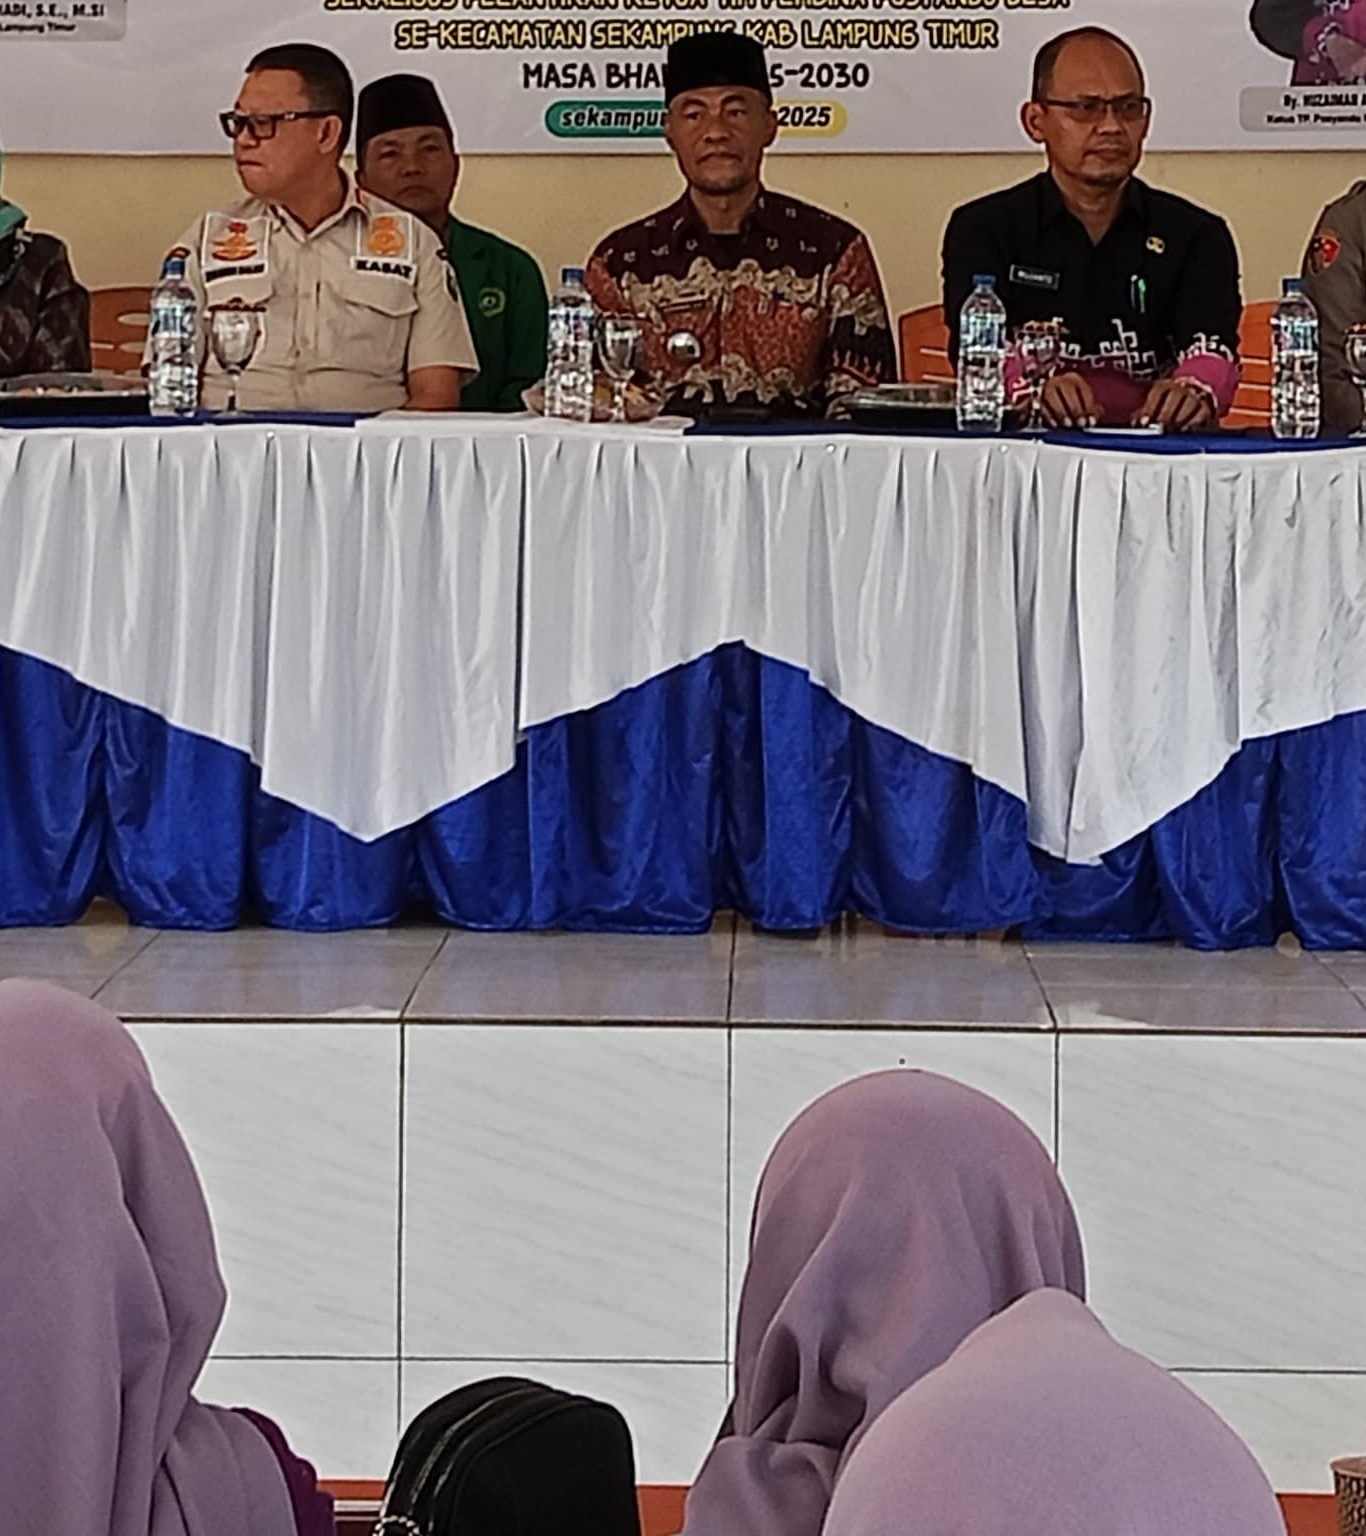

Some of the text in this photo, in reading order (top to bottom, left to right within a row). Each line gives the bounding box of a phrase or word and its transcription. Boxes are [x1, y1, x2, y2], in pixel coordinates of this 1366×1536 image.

[394, 20, 584, 49] SE-KECAMATAN
[742, 19, 796, 48] KAB
[801, 19, 919, 48] LAMPUNG
[924, 20, 1000, 48] TIMUR
[523, 62, 870, 89] MASA BHA 5-2030
[561, 106, 832, 131] sekampu 2025
